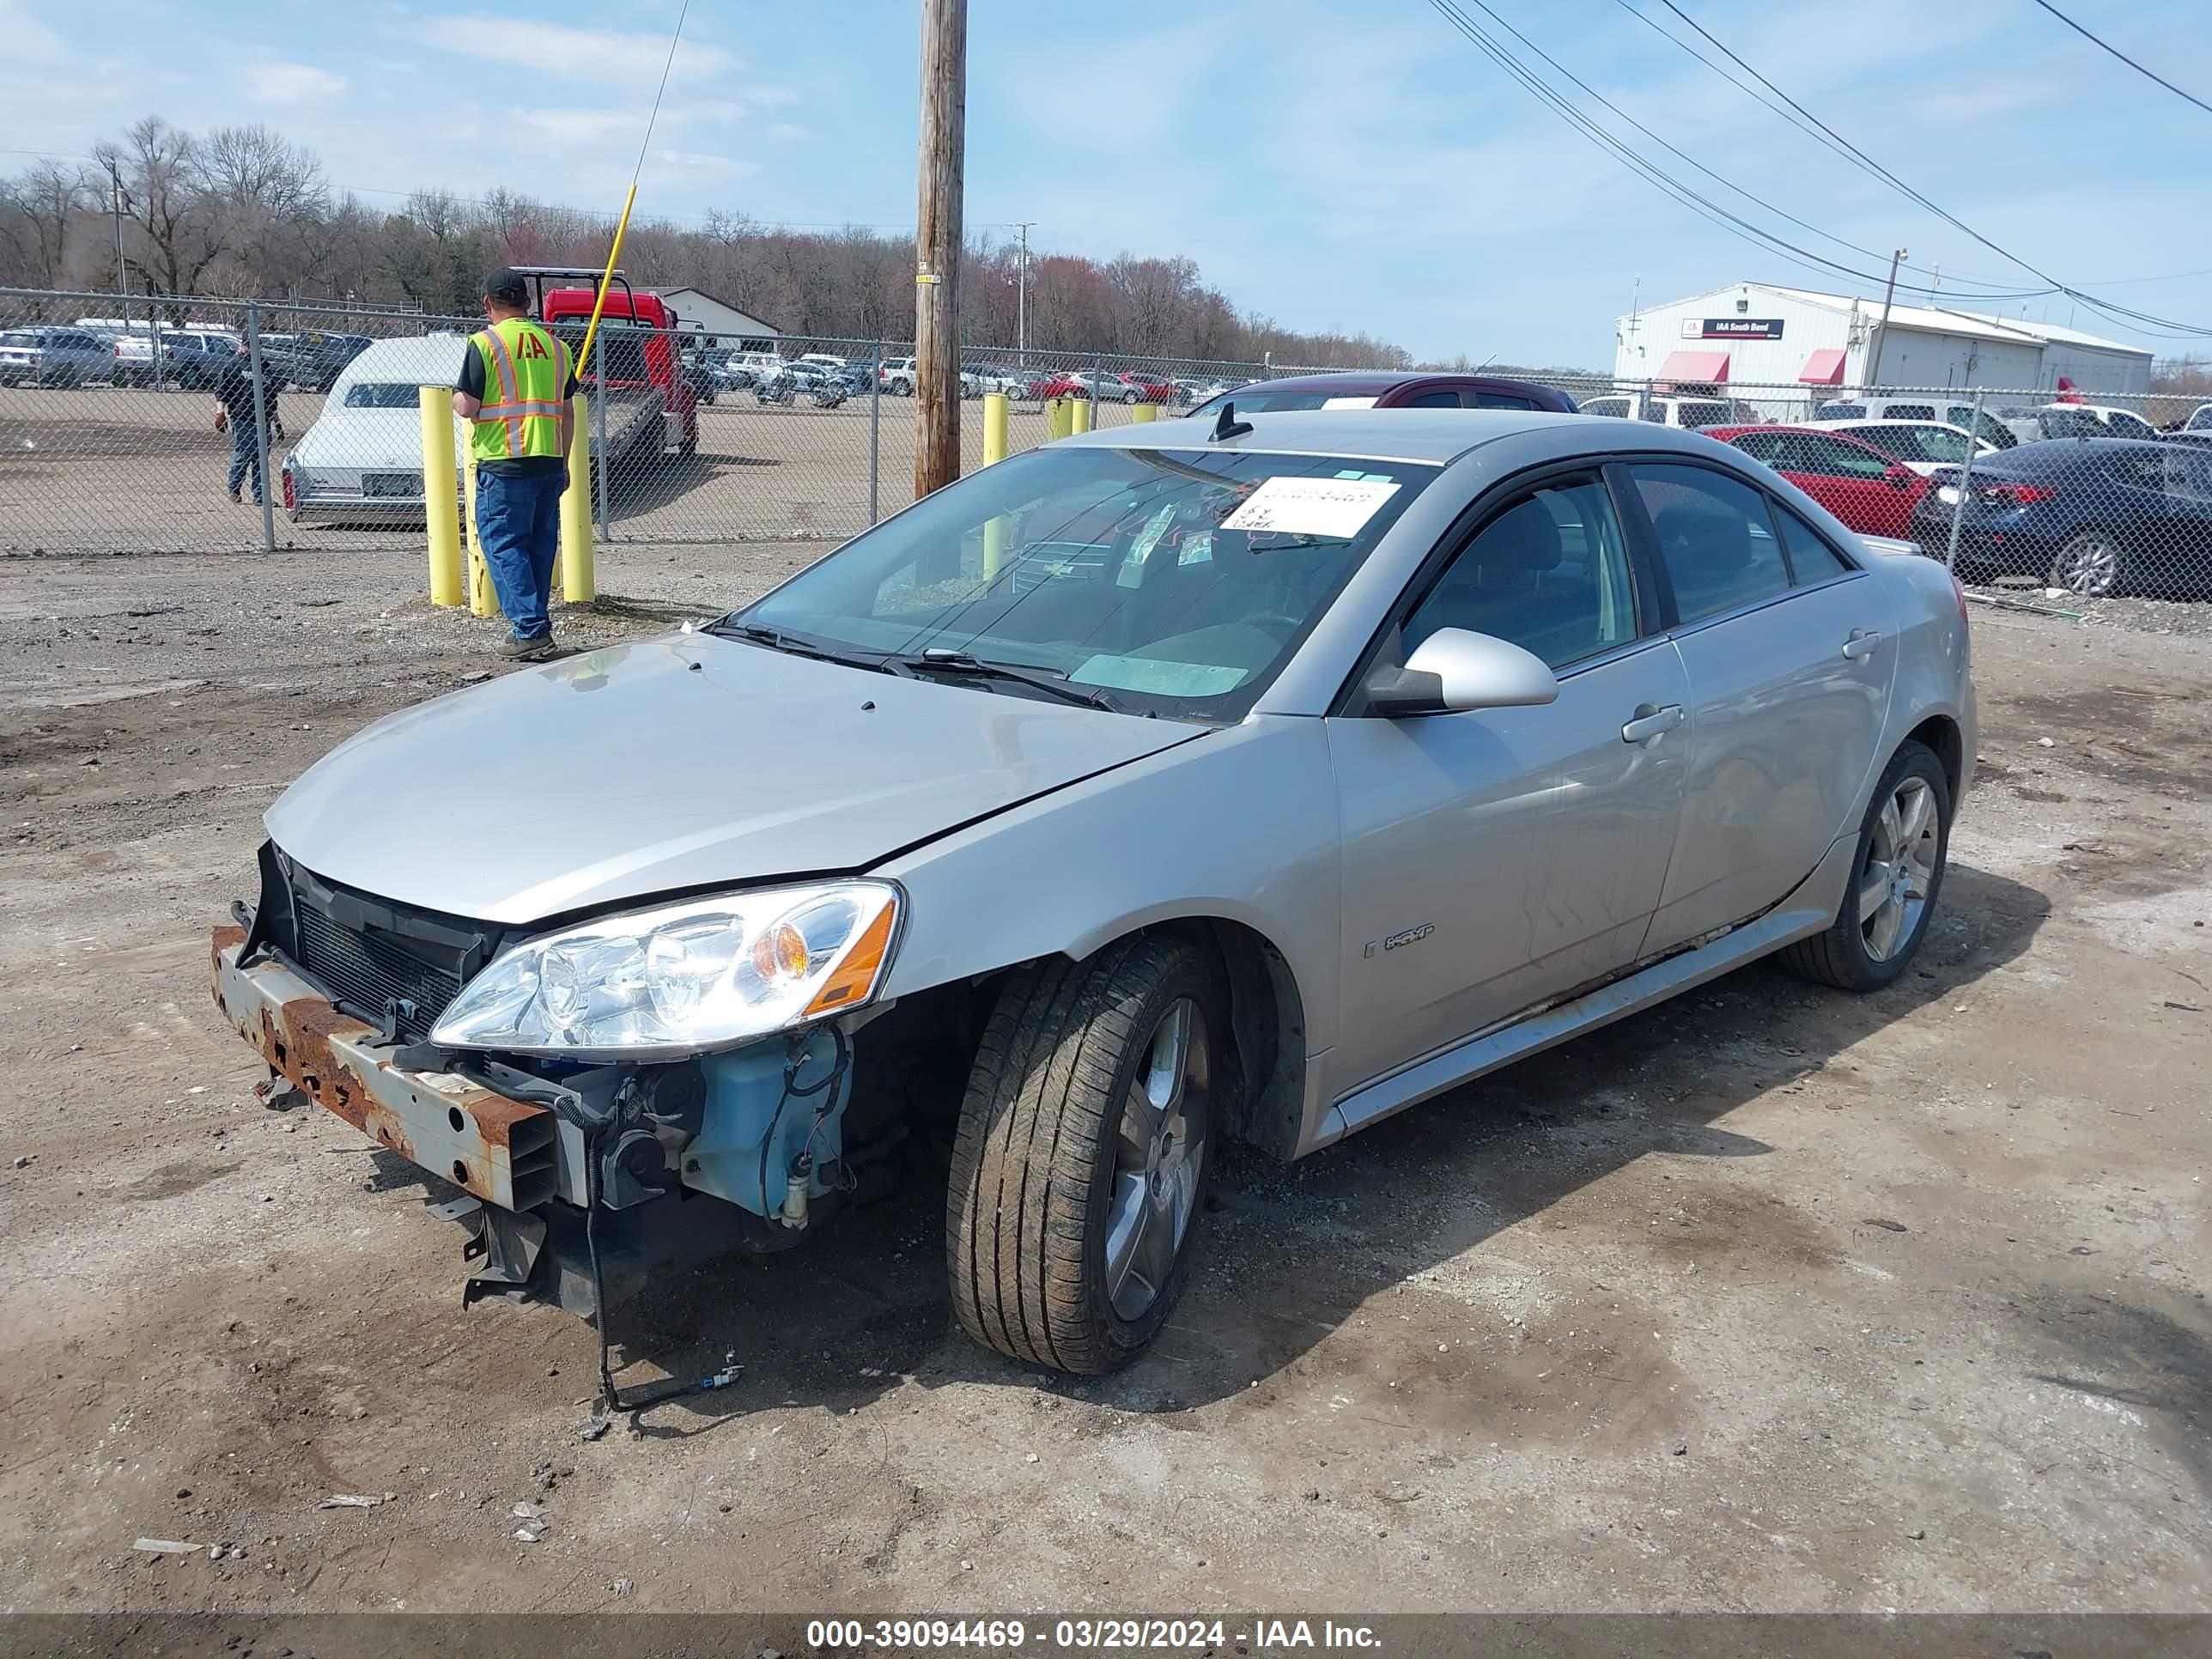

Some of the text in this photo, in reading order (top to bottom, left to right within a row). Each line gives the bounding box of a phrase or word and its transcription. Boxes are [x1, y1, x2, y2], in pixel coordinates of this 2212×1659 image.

[1716, 322, 1769, 331] IAA South Bend
